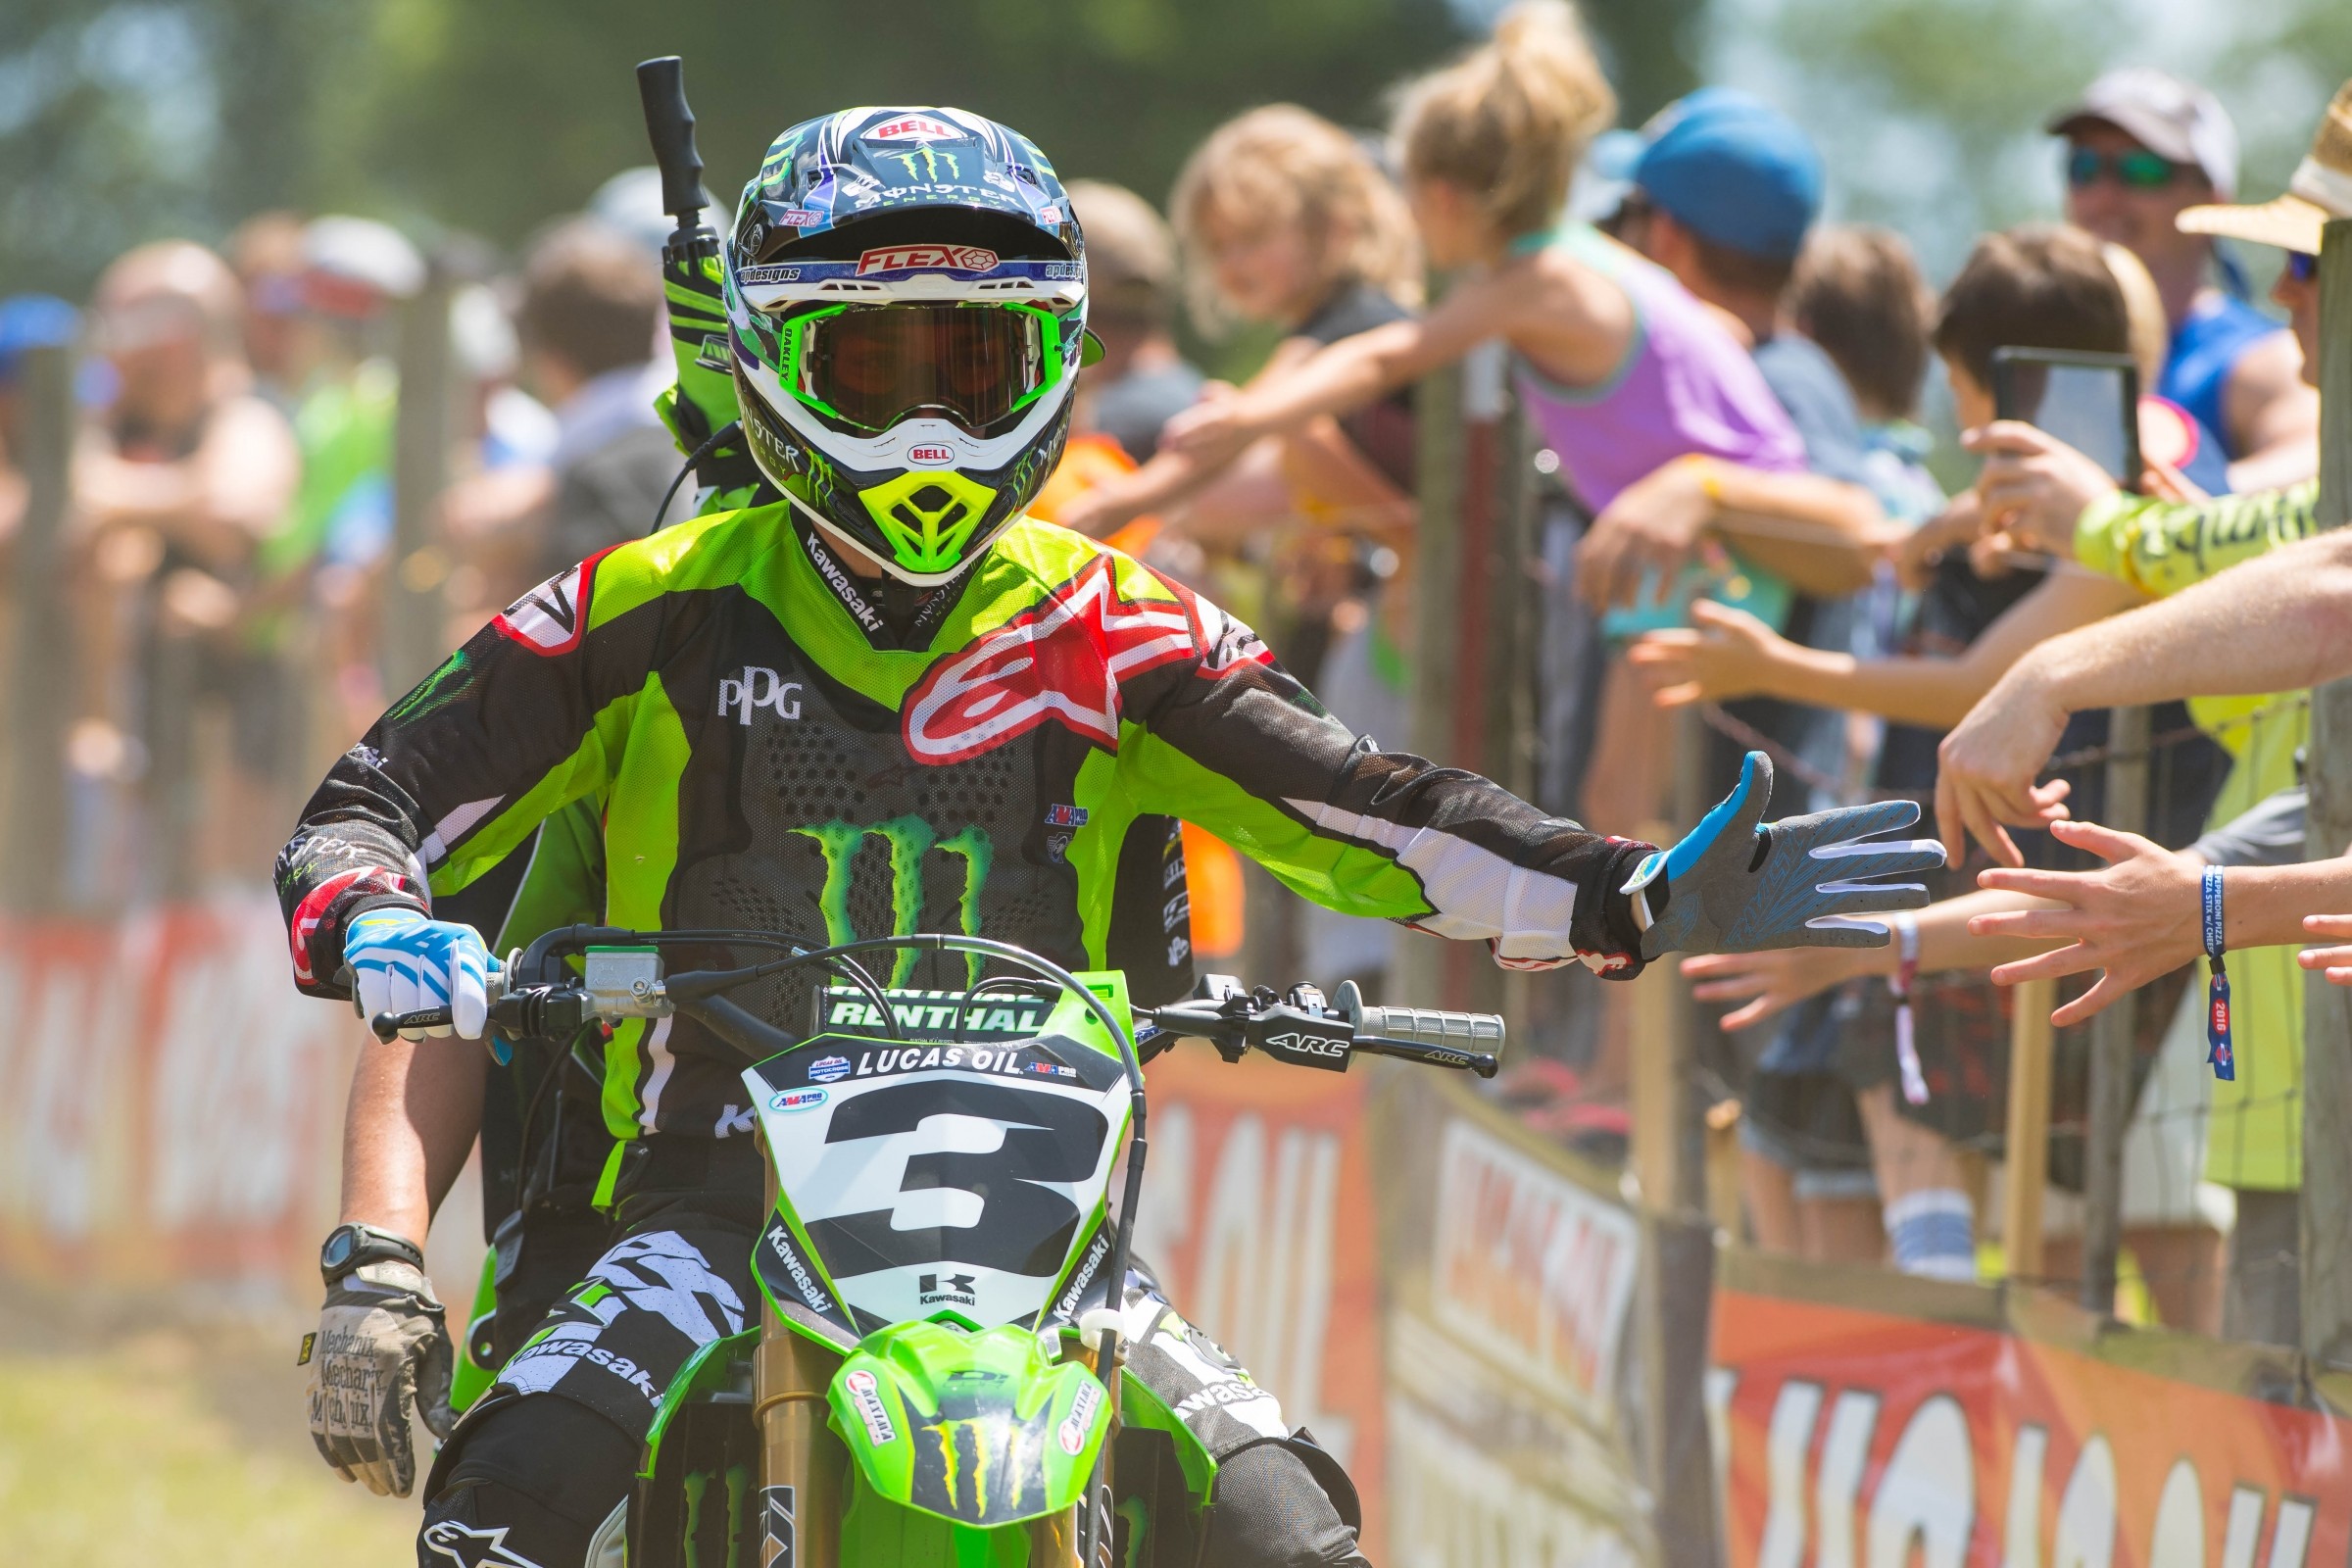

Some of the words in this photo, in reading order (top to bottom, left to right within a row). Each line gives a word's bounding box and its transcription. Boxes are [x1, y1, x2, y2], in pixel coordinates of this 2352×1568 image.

[878, 120, 952, 139] BELL
[855, 183, 1024, 209] MONSTER
[883, 194, 1001, 207] ENERGY
[781, 327, 793, 382] OAKLEY
[912, 449, 950, 461] BELL
[807, 531, 883, 633] Kawasaki
[403, 1011, 441, 1026] ARC
[829, 1002, 1046, 1033] RENTHAL
[2216, 1003, 2227, 1032] 2016
[1266, 1032, 1350, 1058] ARC
[1424, 1050, 1469, 1065] ARC
[810, 1065, 849, 1074] MOTOCROSS
[856, 1048, 963, 1076] LUCAS
[1024, 1061, 1057, 1075] AMA
[775, 1094, 806, 1107] AMA
[804, 1079, 1109, 1280] 3
[766, 1225, 832, 1314] Kawasaki
[1053, 1234, 1109, 1322] Kawasaki
[919, 1294, 976, 1306] Kawasaki
